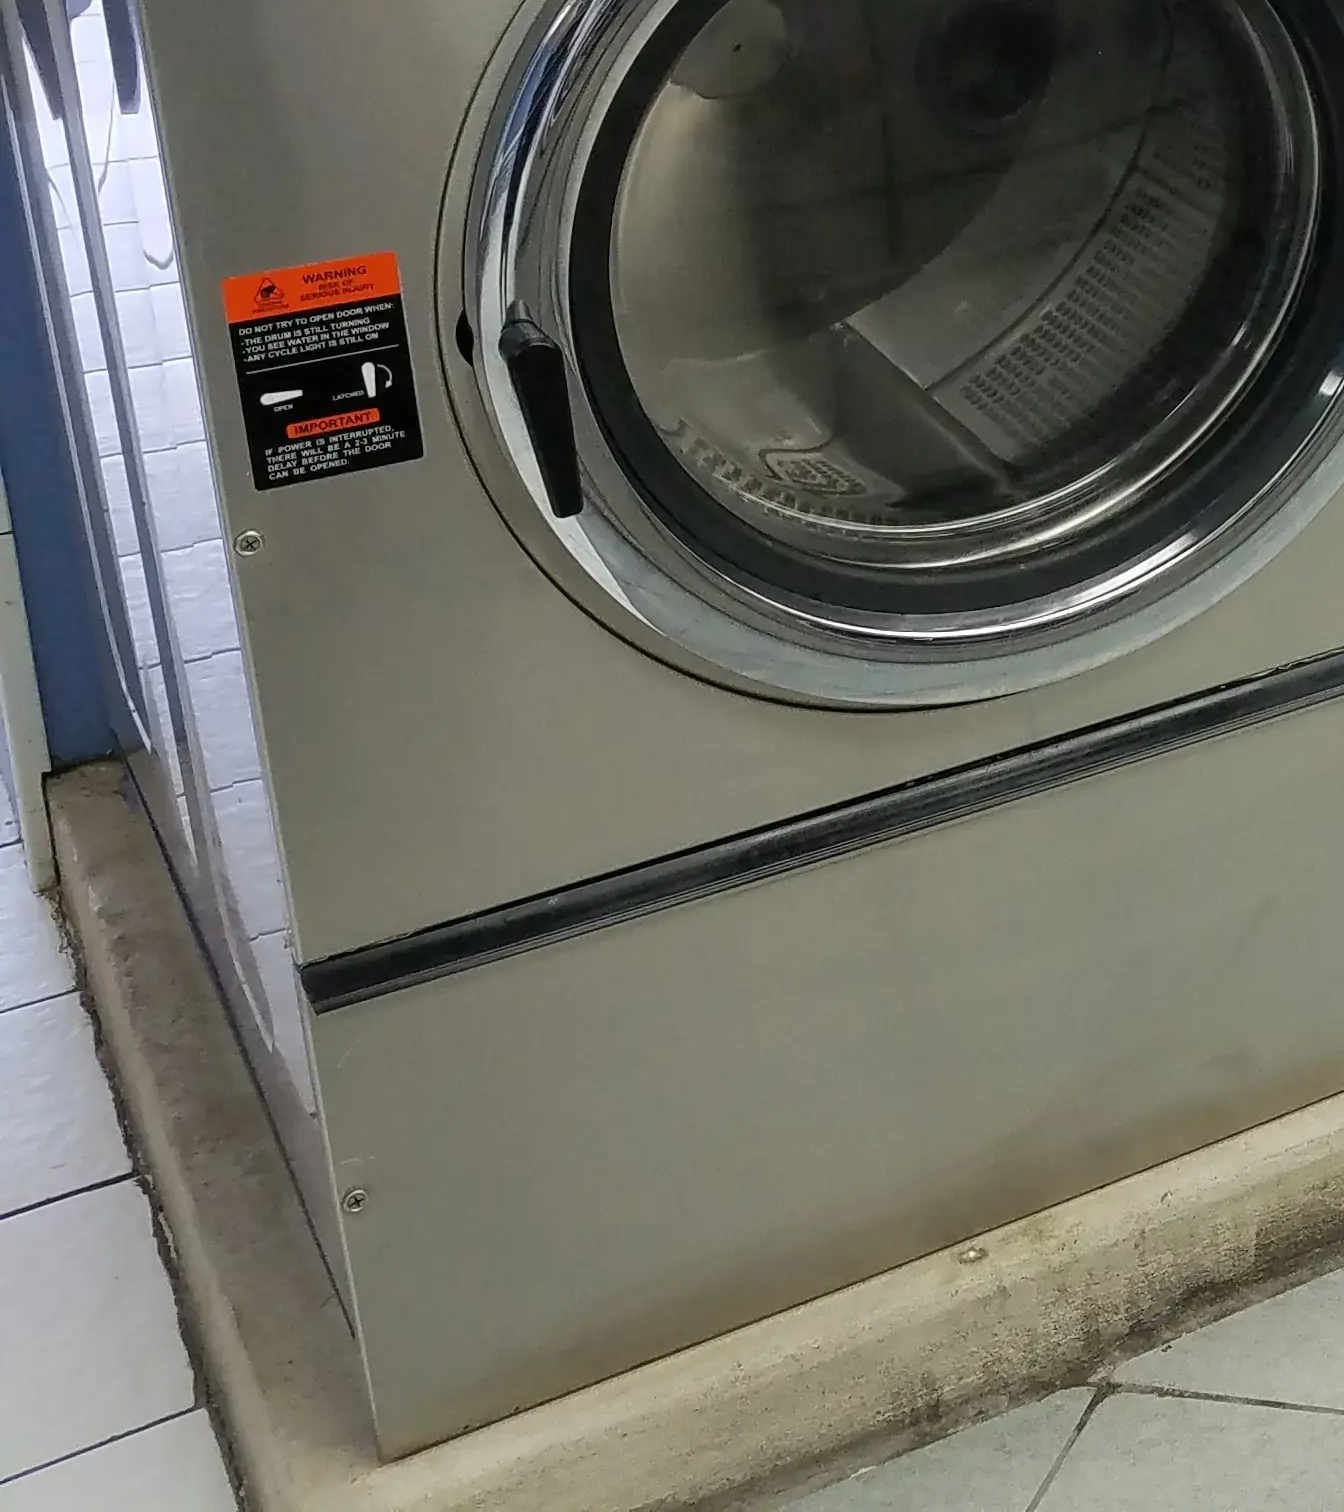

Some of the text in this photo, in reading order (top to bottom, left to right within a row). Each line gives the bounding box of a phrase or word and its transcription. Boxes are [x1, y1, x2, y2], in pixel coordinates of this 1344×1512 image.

[302, 266, 367, 284] WARNING
[239, 327, 252, 336] DO
[255, 324, 273, 334] NOT
[276, 320, 293, 330] TRY
[295, 318, 307, 326] TO
[310, 313, 334, 323] OPEN
[337, 308, 363, 319] DOOR
[265, 332, 291, 343] DRUM
[294, 329, 302, 337] IS
[304, 325, 328, 336] STILL
[331, 317, 370, 331] TURNING
[268, 341, 285, 351] SEE
[287, 335, 319, 347] WATER
[321, 333, 330, 341] IN
[332, 329, 349, 339] THE
[351, 322, 390, 335] WINDOW
[269, 348, 299, 359] CYCLE
[300, 342, 327, 353] LIGHT
[329, 339, 337, 347] IS
[340, 335, 363, 345] STILL
[366, 332, 379, 341] ON
[274, 404, 293, 412] OPEN
[294, 412, 371, 435] IMPORTANT
[265, 448, 275, 456] IF
[278, 441, 312, 454] POWER
[267, 454, 297, 464] THERE
[301, 448, 323, 459] WILL
[328, 444, 340, 452] BE
[372, 430, 405, 444] MINUTE
[268, 442, 392, 472] DELAY BEFORE THE DOOR
[269, 469, 288, 480] CAN
[293, 466, 306, 475] BE
